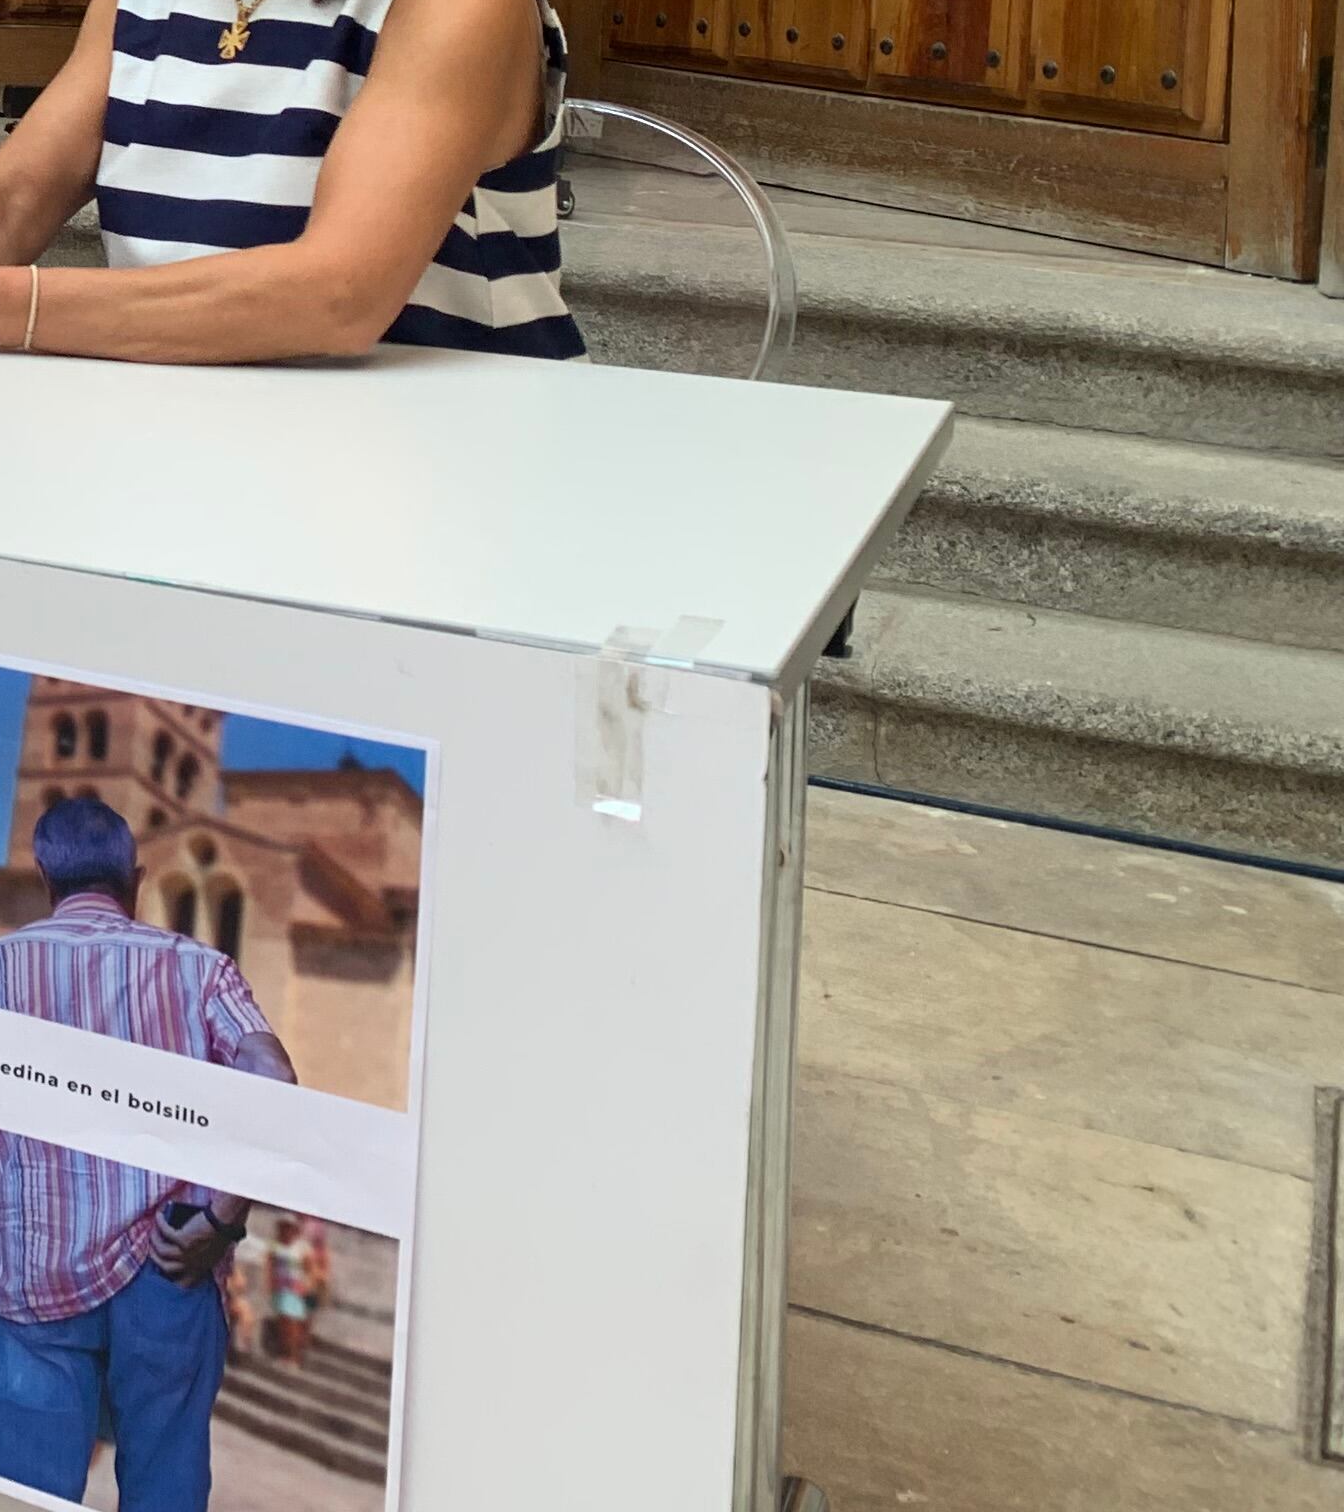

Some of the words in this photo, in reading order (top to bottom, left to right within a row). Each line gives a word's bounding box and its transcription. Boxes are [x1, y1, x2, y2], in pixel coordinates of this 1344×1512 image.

[67, 1080, 92, 1096] en
[101, 1087, 119, 1104] el
[128, 1093, 209, 1127] bolsillo
